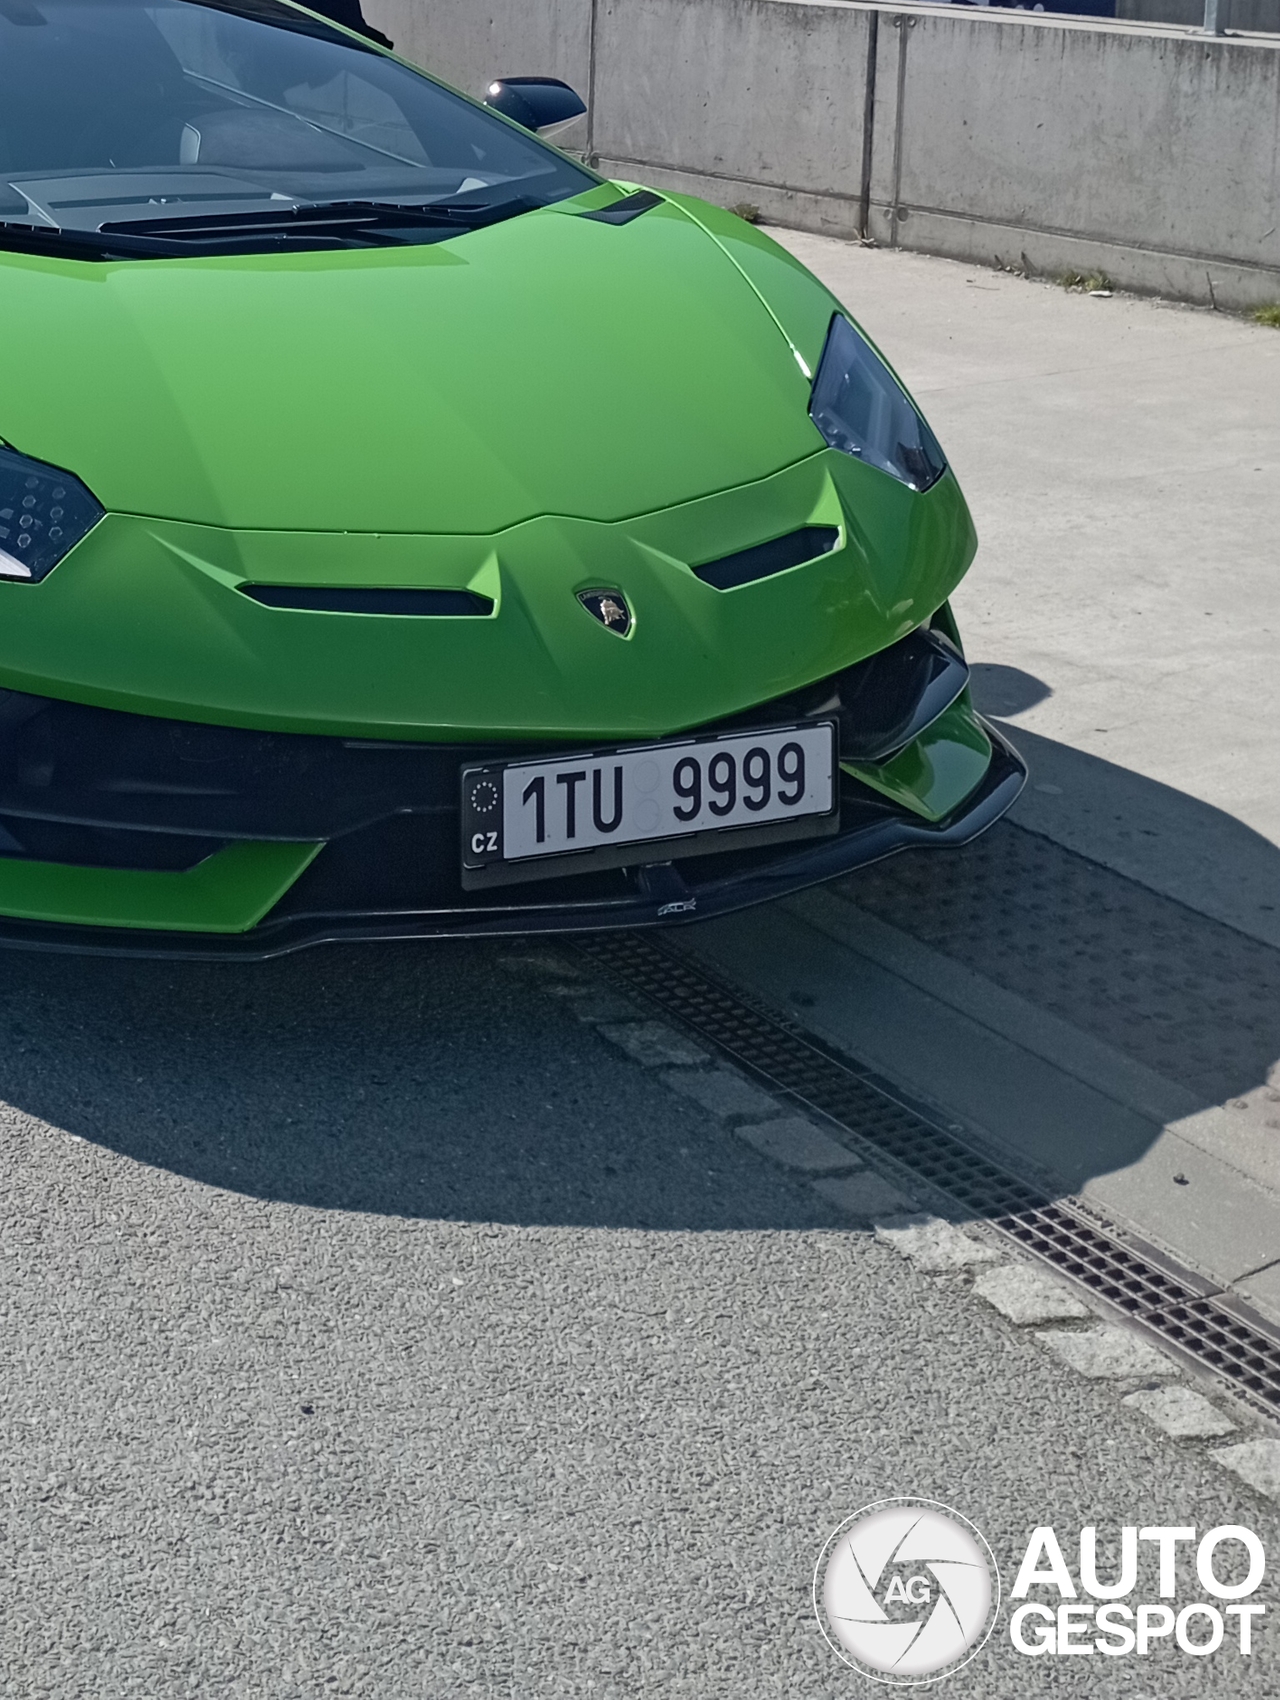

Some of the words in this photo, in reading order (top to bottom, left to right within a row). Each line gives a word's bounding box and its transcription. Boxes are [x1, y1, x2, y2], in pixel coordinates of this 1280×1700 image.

[521, 765, 623, 843] 1TU
[672, 741, 806, 821] 9999
[471, 831, 498, 854] CZ
